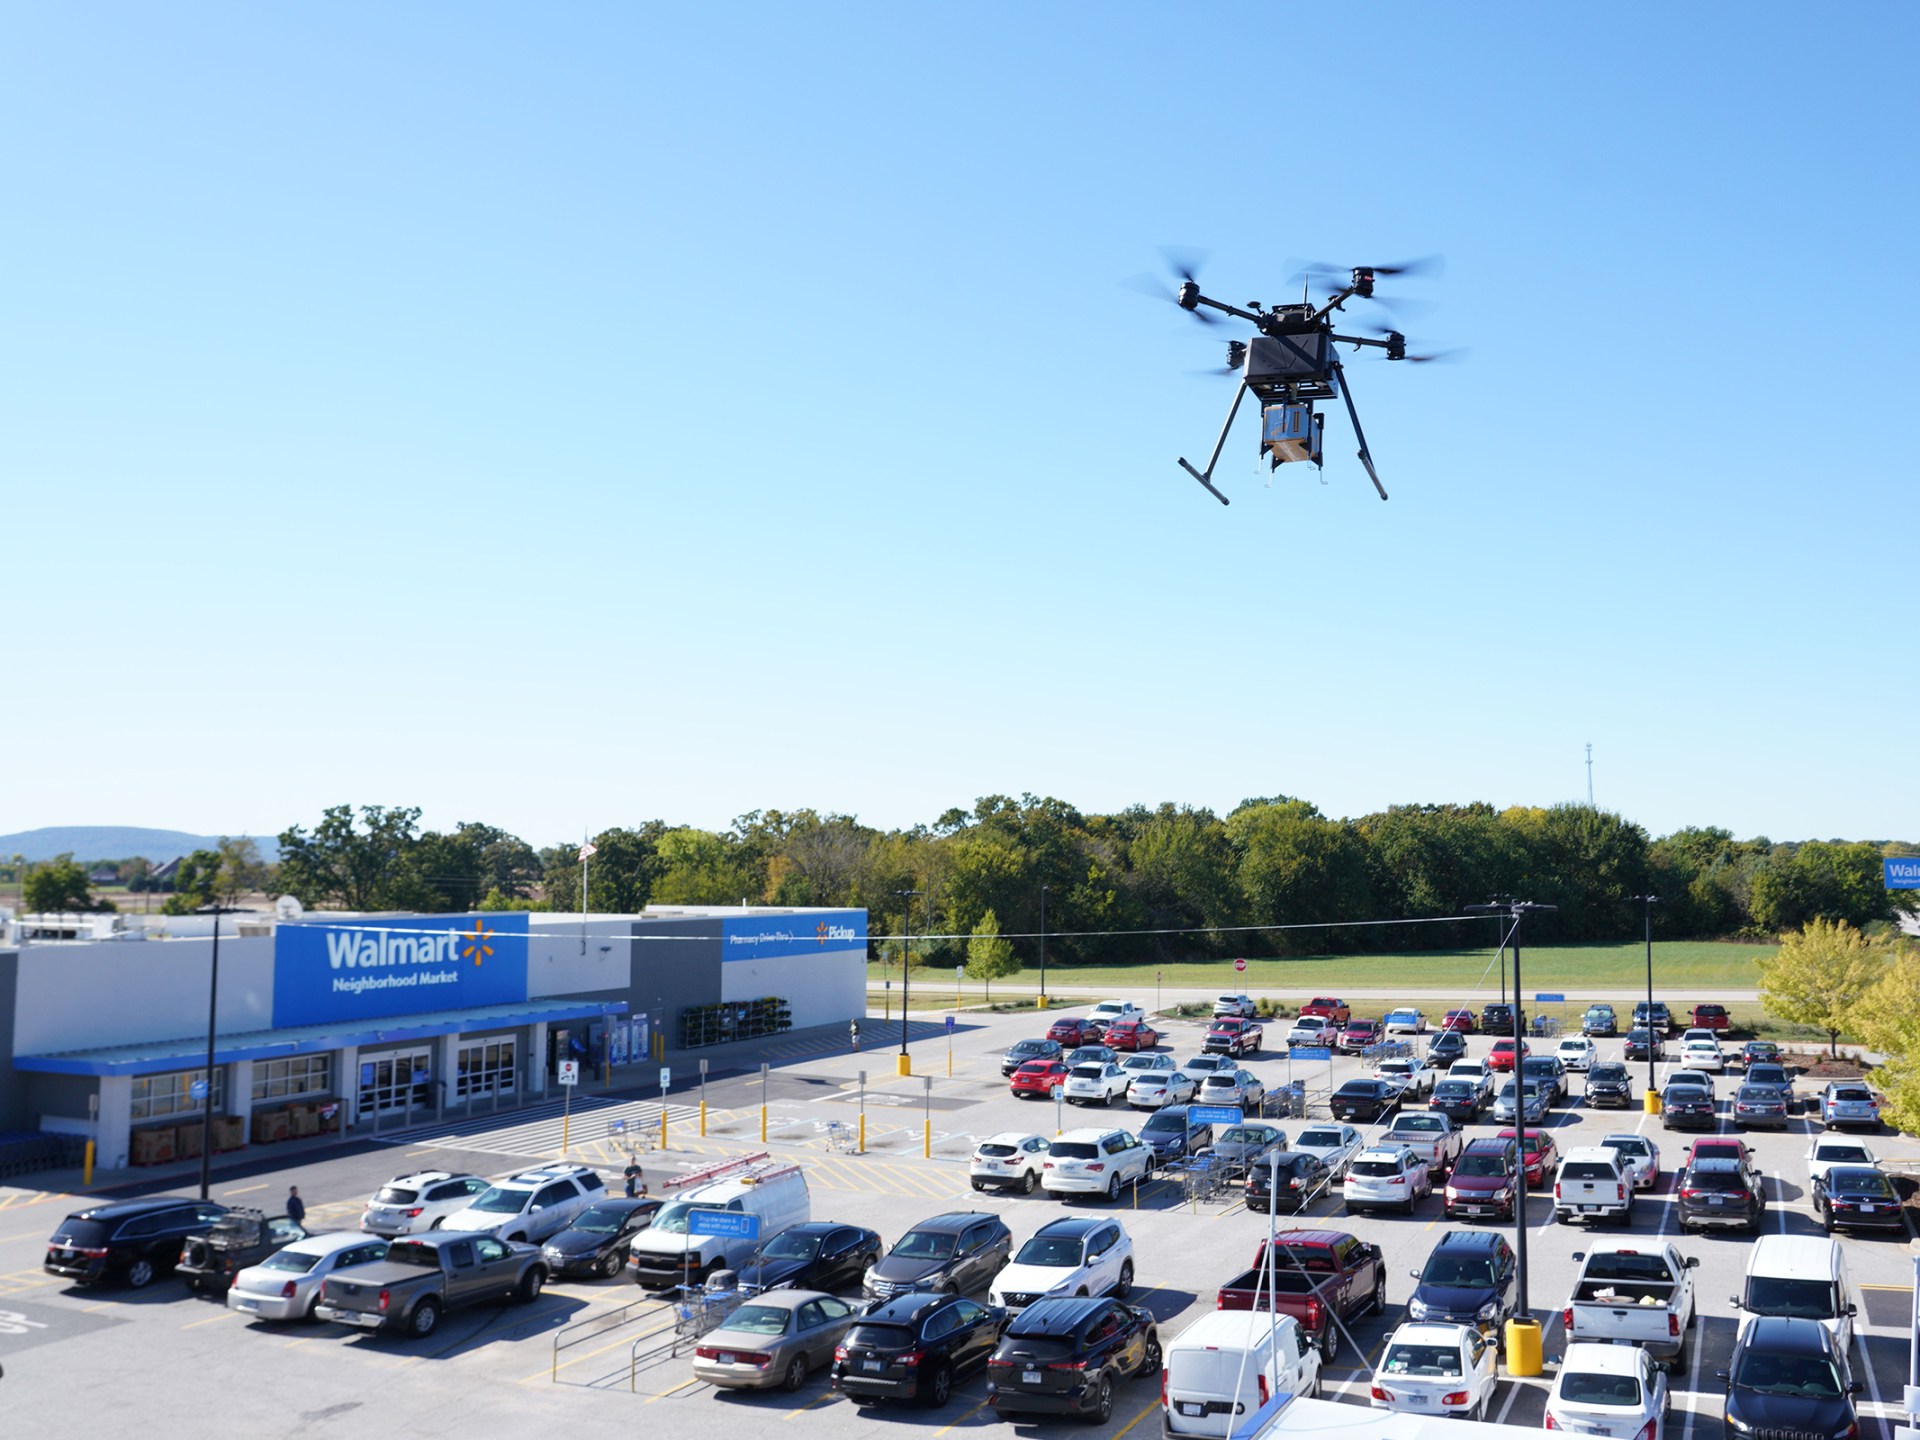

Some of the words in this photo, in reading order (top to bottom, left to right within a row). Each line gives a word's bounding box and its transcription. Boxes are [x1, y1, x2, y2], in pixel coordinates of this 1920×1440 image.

[730, 934, 758, 945] Pharmacy
[829, 925, 855, 942] Pickup
[326, 927, 459, 969] Walmart
[332, 972, 417, 994] Neighborhood
[419, 971, 458, 986] Market
